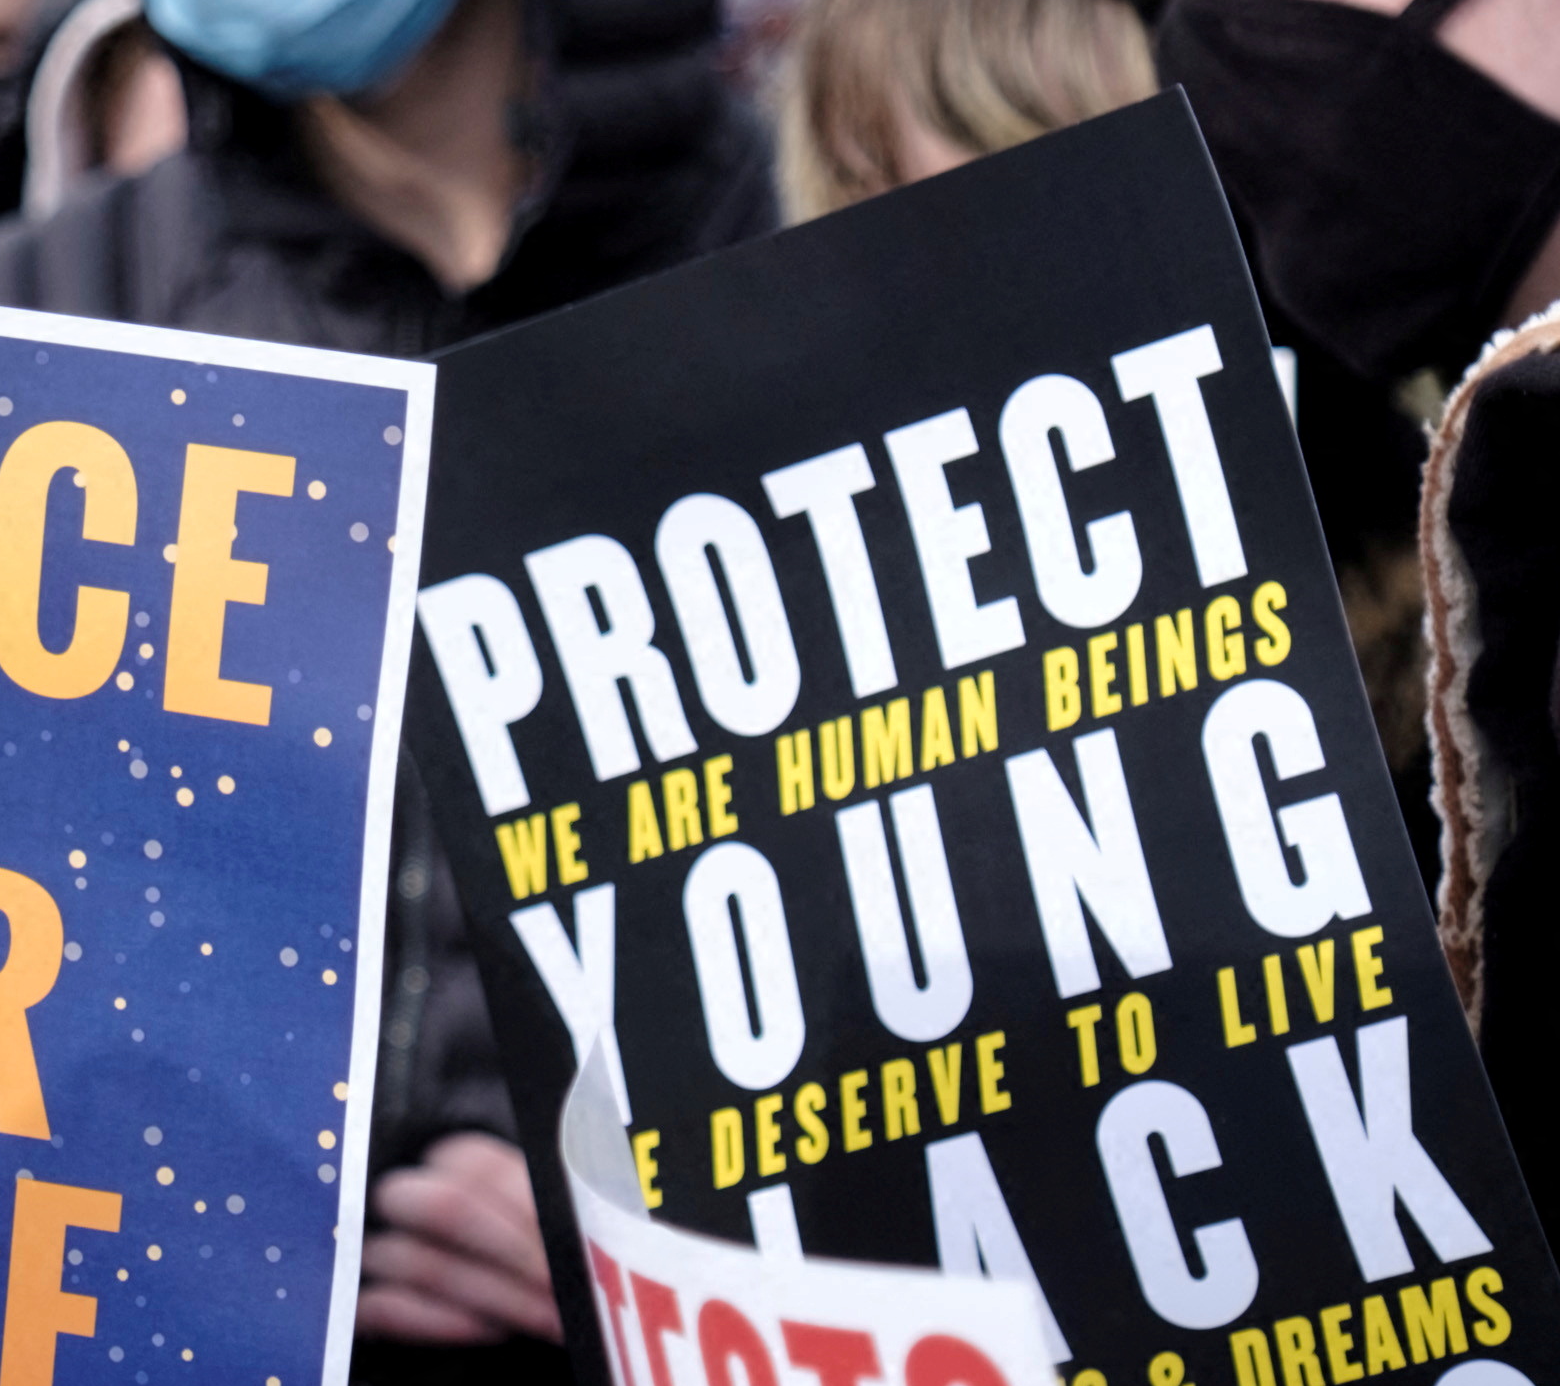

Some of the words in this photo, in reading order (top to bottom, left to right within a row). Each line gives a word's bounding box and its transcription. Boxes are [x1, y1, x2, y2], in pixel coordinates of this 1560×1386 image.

[416, 324, 1248, 817] PROTECT
[494, 802, 589, 901] WE
[628, 753, 739, 865] ARE
[777, 671, 1000, 818] HUMAN
[1045, 581, 1293, 733] BEINGS
[509, 678, 1373, 1126] YOUNG
[630, 1128, 664, 1211] E
[710, 1030, 1013, 1190] DESERVE
[1068, 990, 1158, 1089] TO
[1218, 926, 1395, 1050] LIVE
[747, 1014, 1495, 1365] ACK
